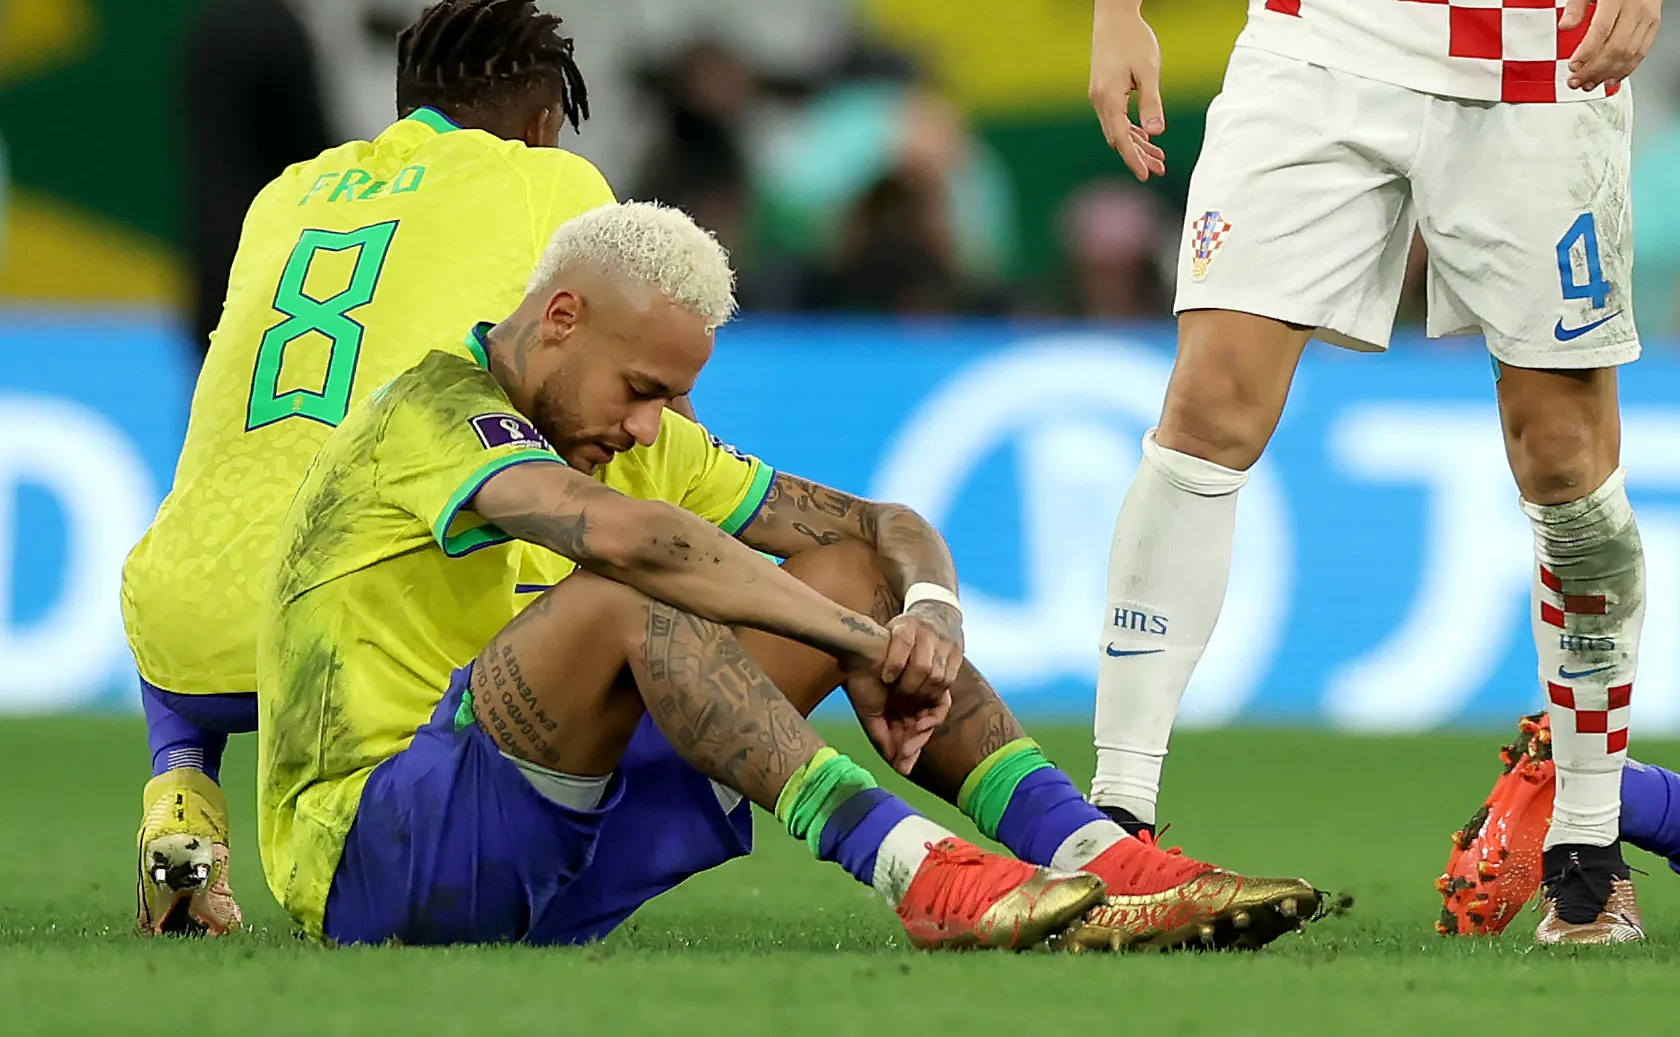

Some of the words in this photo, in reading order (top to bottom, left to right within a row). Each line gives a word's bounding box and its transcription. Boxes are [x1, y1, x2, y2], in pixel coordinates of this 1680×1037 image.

[298, 165, 425, 207] FRED
[1555, 211, 1613, 310] 4
[245, 220, 400, 431] 8
